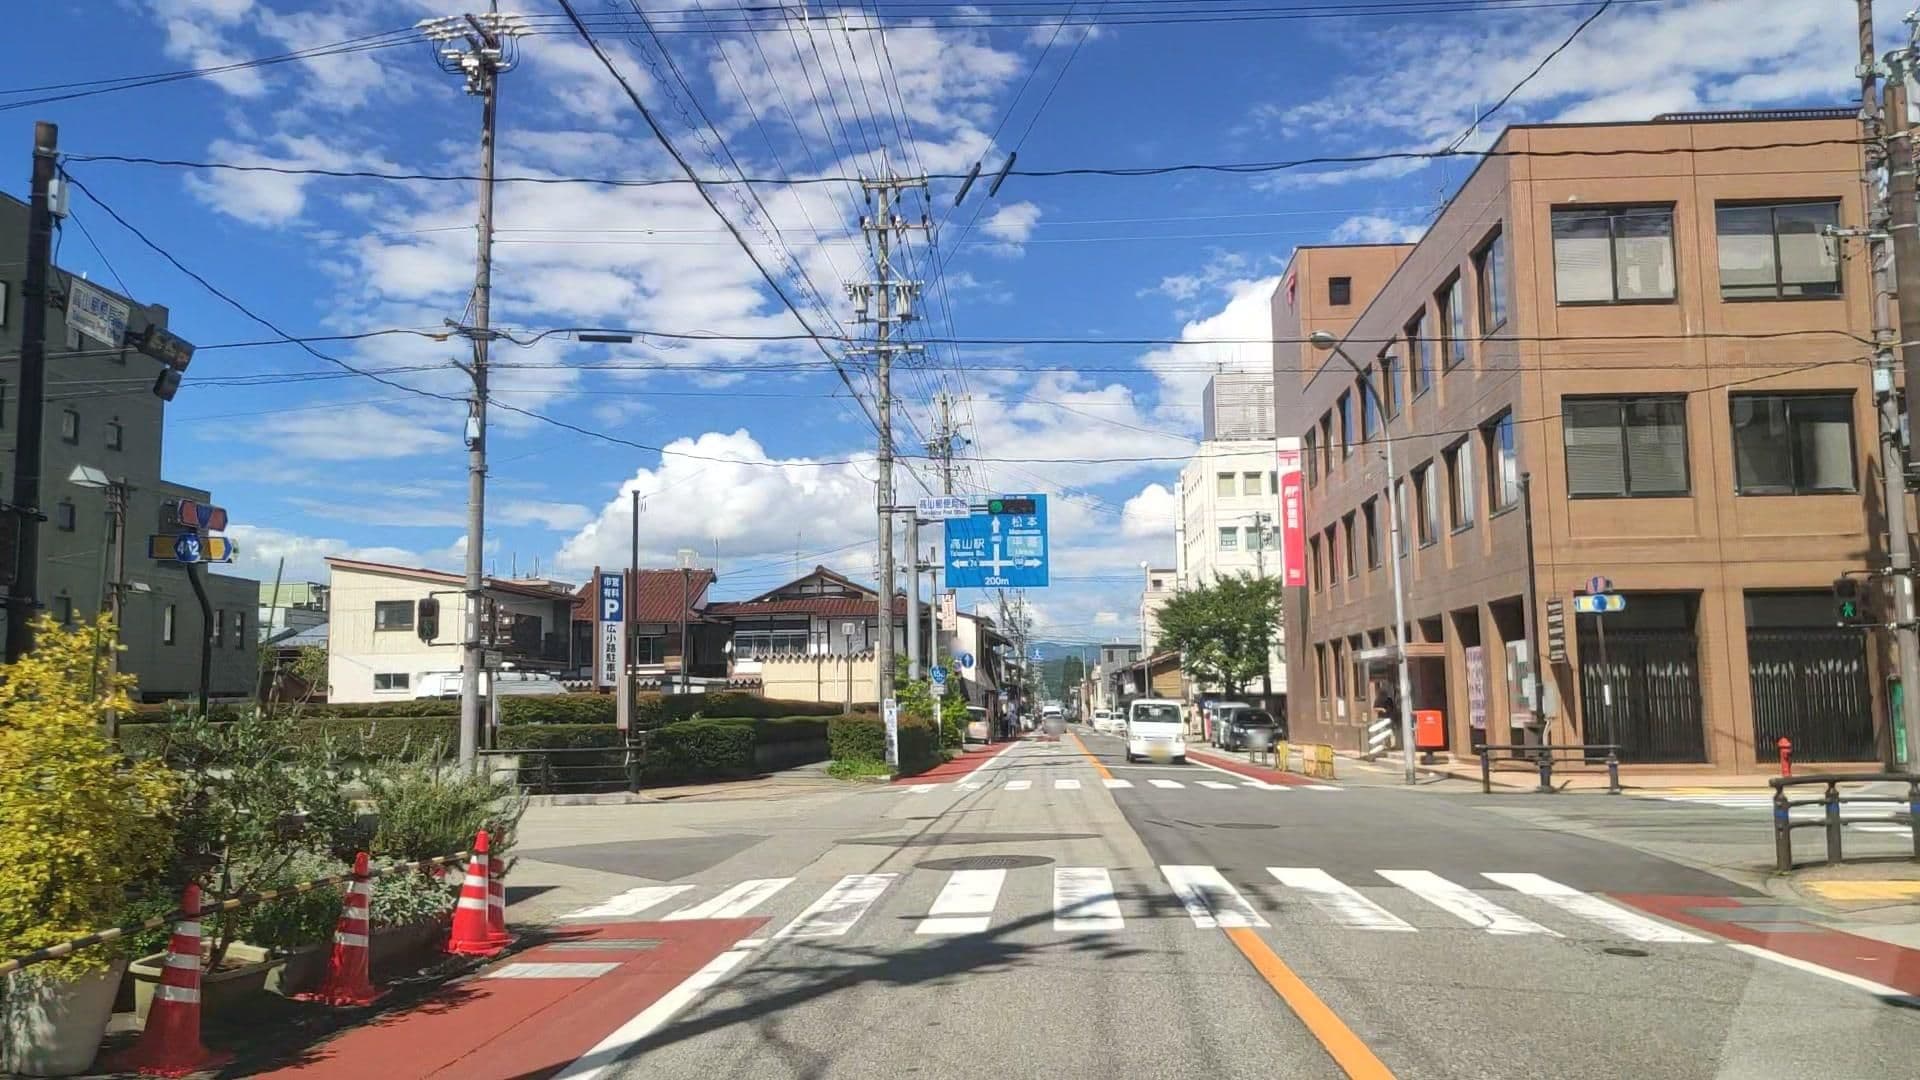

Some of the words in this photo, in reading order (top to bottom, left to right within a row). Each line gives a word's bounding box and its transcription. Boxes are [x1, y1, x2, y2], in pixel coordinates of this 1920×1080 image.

[950, 538, 985, 550] 高山駅
[603, 576, 620, 587] 市営
[984, 577, 1010, 586] 200m
[604, 599, 620, 620] P
[606, 623, 617, 682] 広小路駐車場
